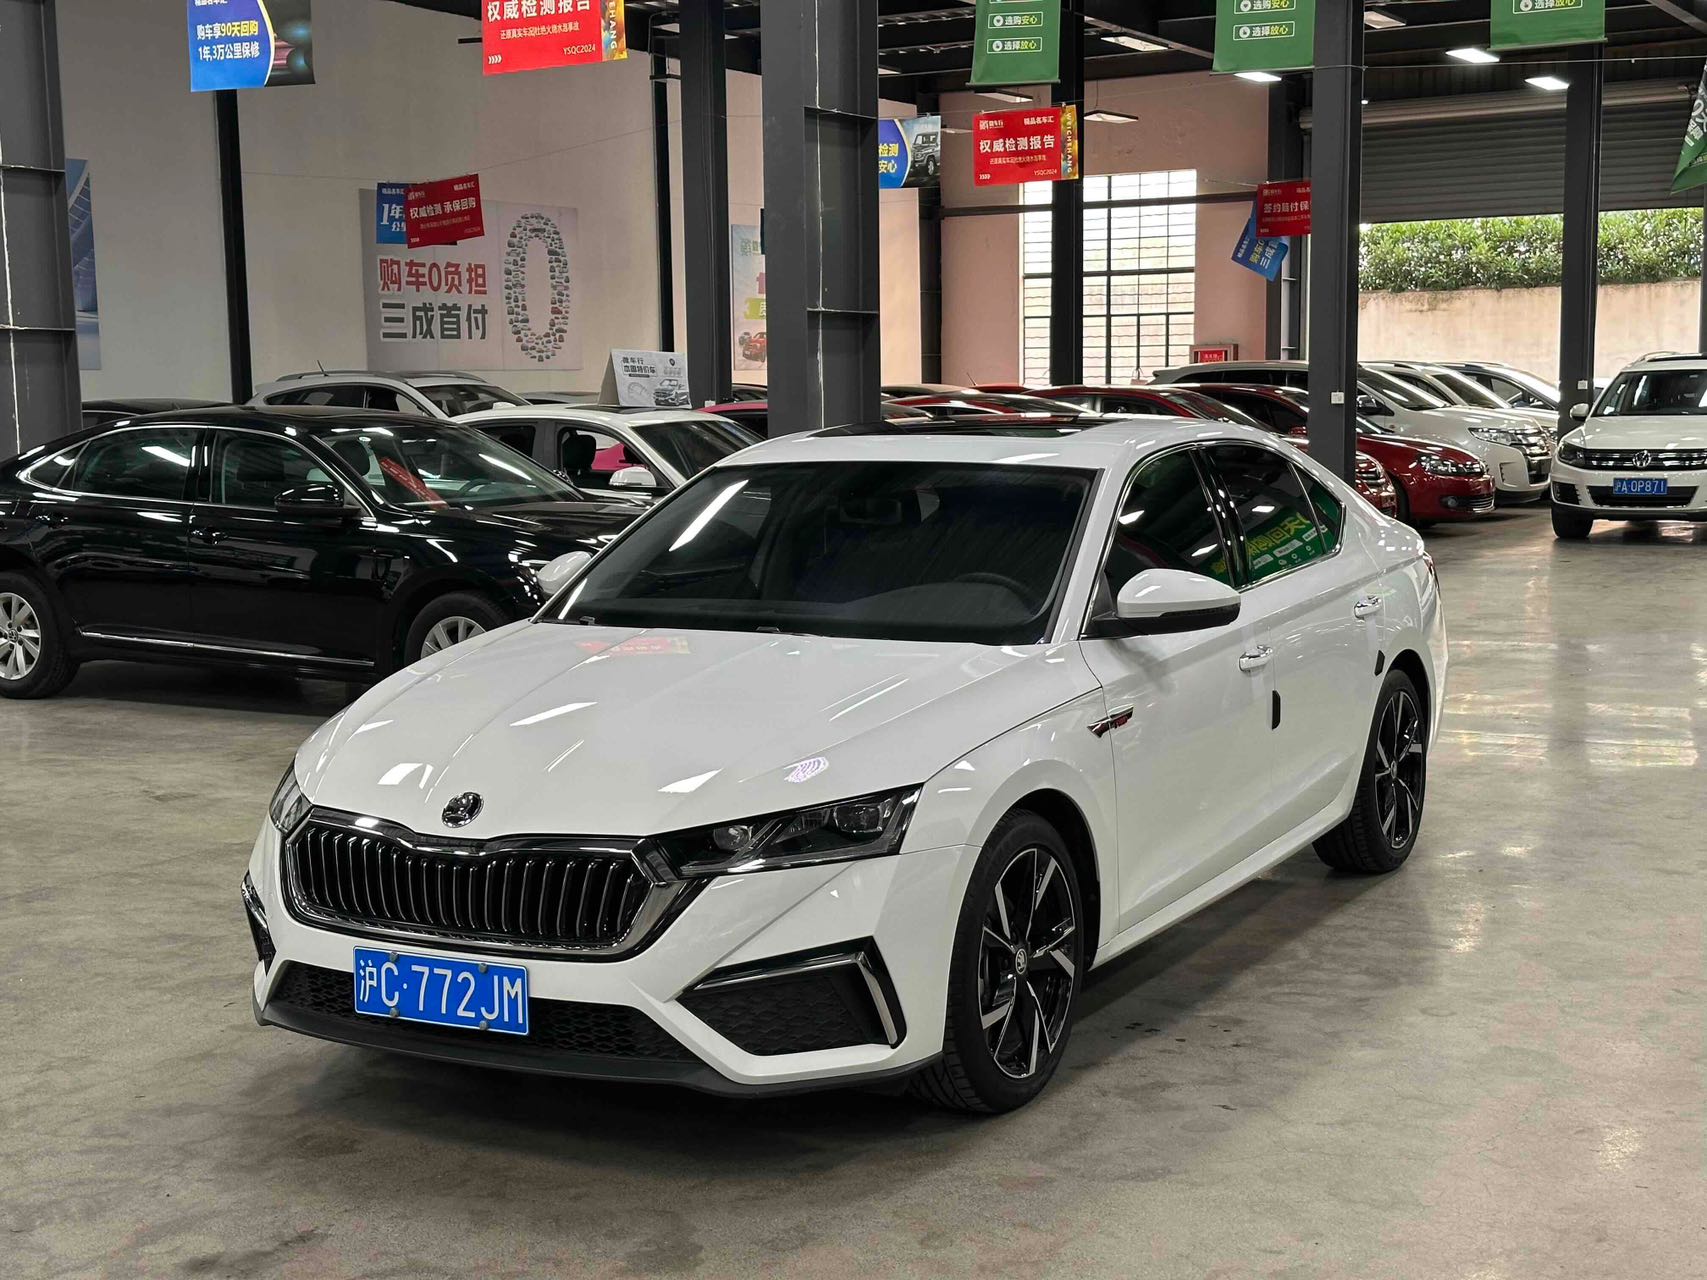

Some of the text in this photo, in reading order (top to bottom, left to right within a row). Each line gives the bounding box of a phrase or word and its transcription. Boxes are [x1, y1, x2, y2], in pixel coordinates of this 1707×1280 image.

[196, 20, 259, 40] 购车享90天回购
[1252, 25, 1289, 37] 选择放心
[563, 43, 596, 55] YSQC2024
[979, 134, 1055, 154] 权威检测报告
[379, 257, 488, 296] 购车0负担
[380, 302, 489, 340] 三成首付
[359, 959, 524, 1024] 沪C·772JM
